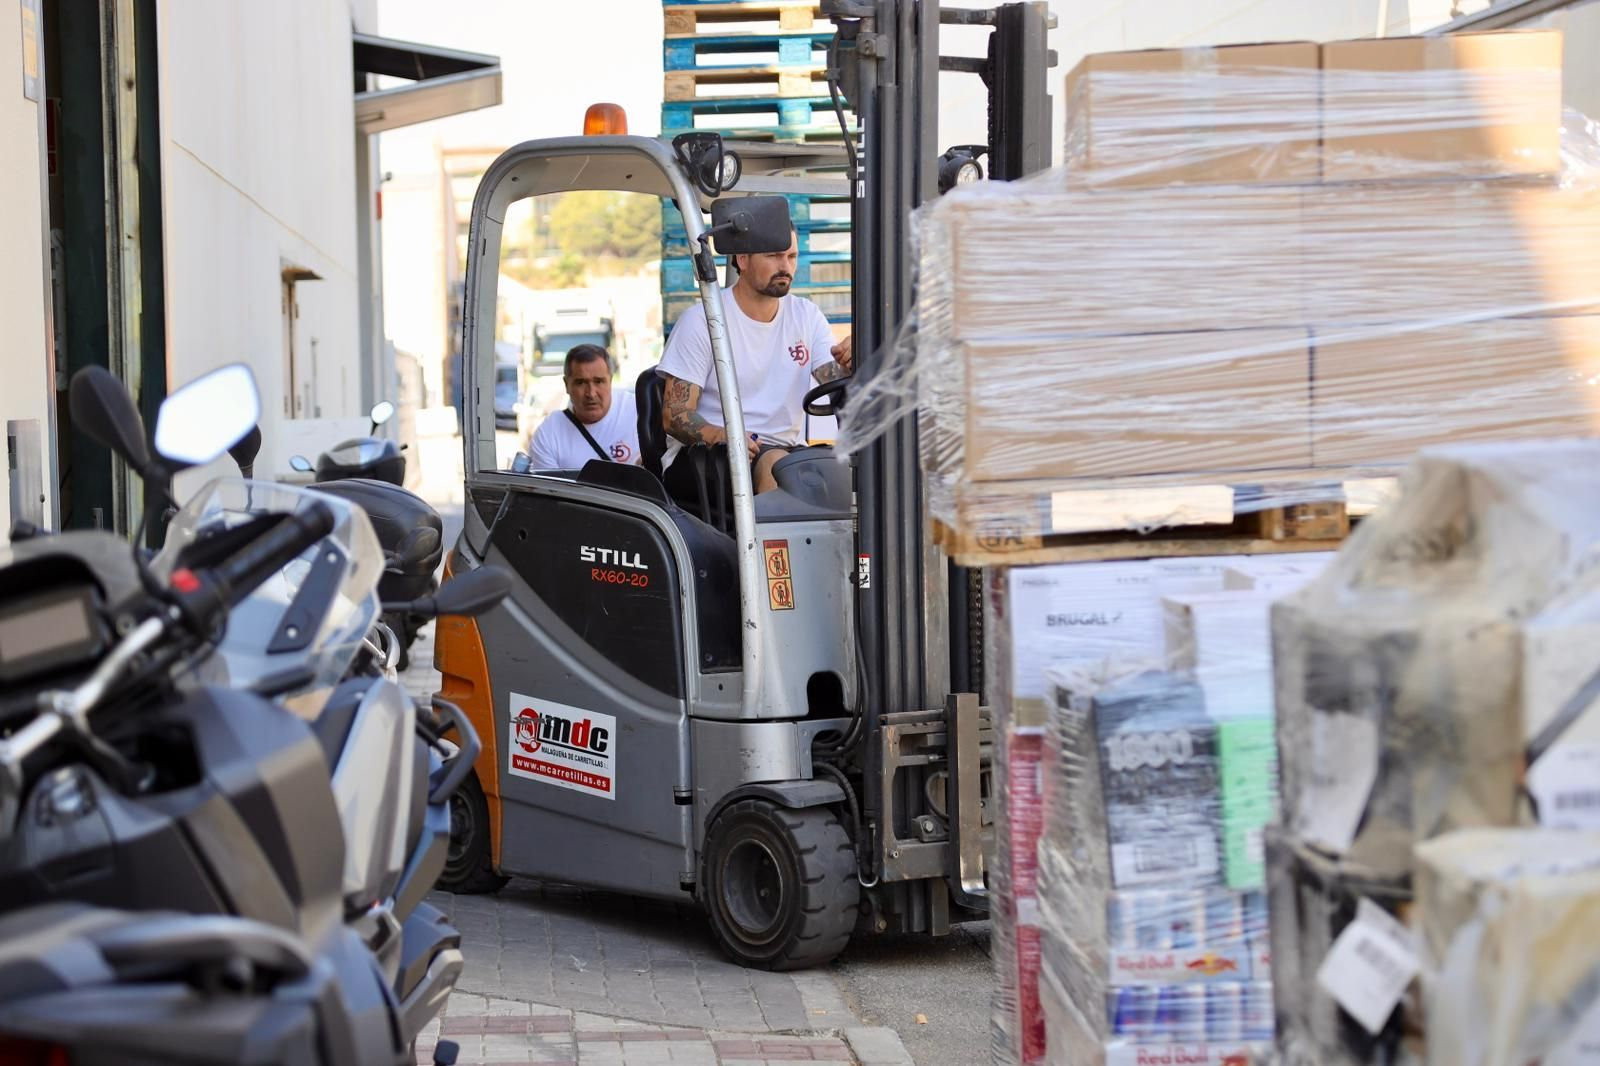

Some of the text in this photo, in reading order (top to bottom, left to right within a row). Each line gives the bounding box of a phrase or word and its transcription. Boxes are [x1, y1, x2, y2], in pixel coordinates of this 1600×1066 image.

[856, 117, 866, 199] STILL
[580, 545, 649, 570] STILL
[591, 567, 649, 588] RX60-20
[542, 713, 609, 753] mdc
[541, 746, 567, 759] MALAGUEÑA
[568, 753, 574, 761] DE
[574, 754, 604, 768] CARRETILLAS
[516, 759, 608, 789] www.mcarretillas.es
